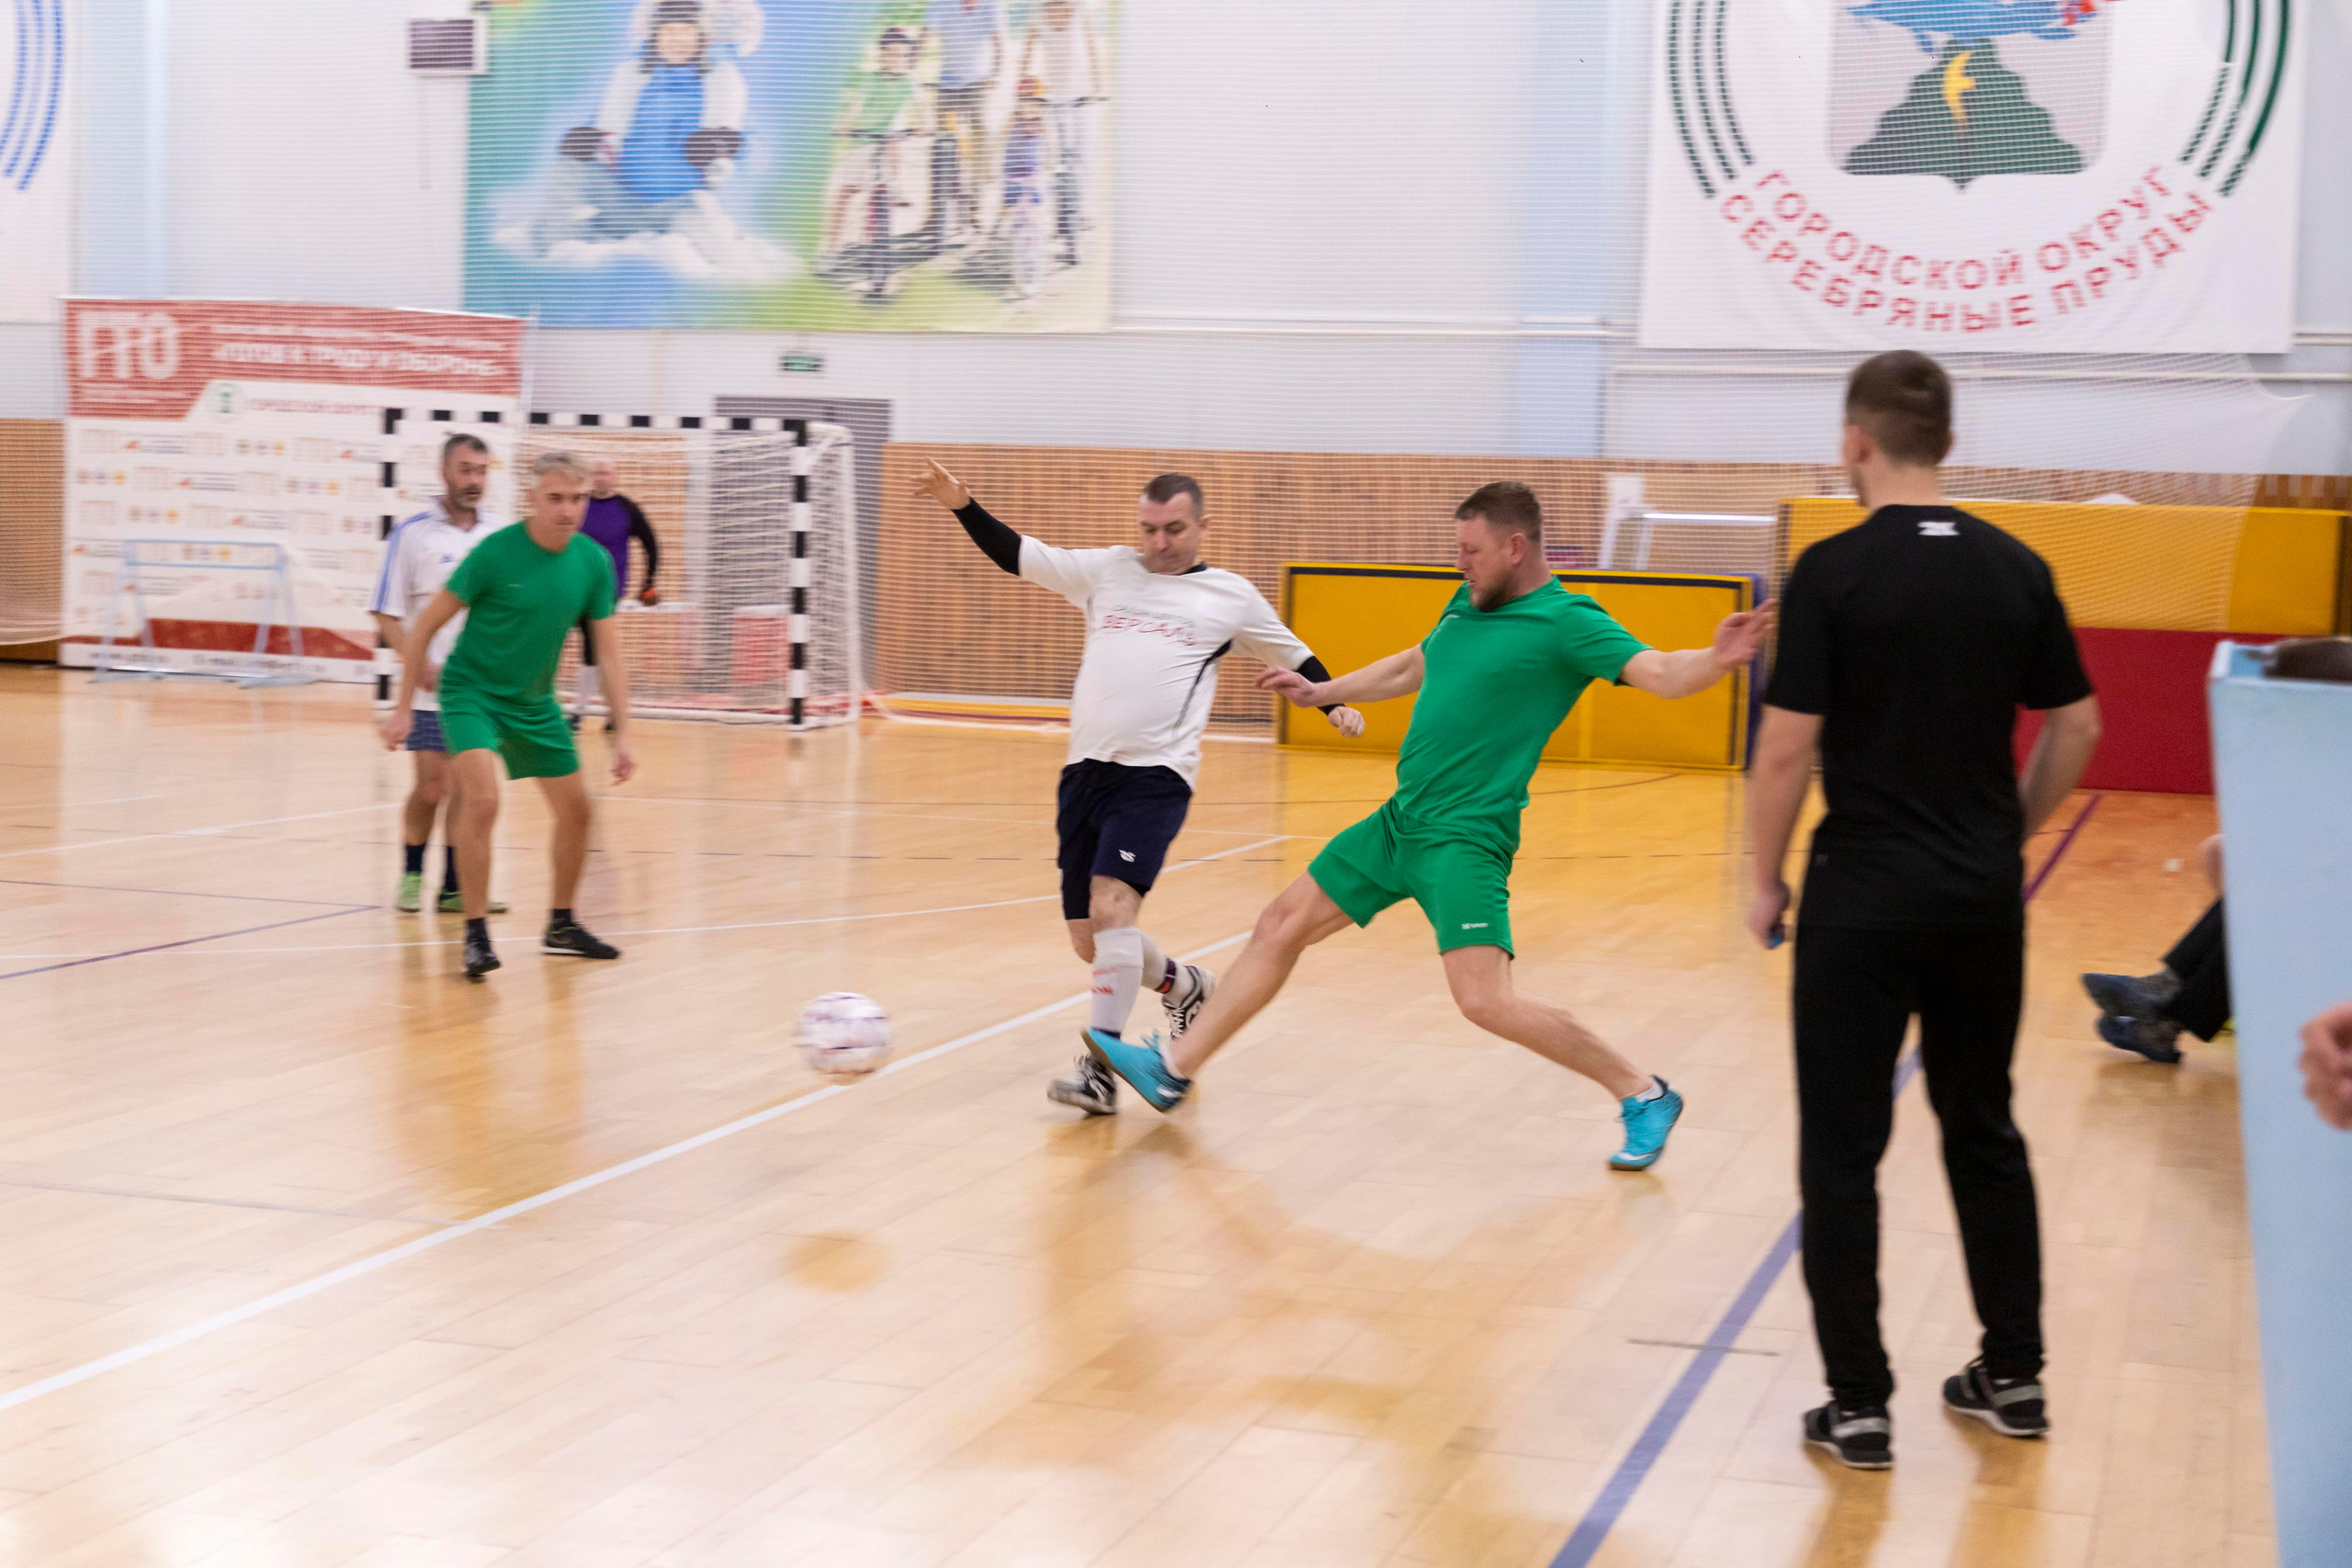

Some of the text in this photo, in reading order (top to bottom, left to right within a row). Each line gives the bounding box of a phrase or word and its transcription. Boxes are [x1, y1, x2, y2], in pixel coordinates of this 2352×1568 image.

[1720, 191, 2213, 333] СЕРЕБРЯНЫЕ ПРУДЫ
[1755, 165, 2172, 290] ГОРОДСКОЙ ОКРУГ
